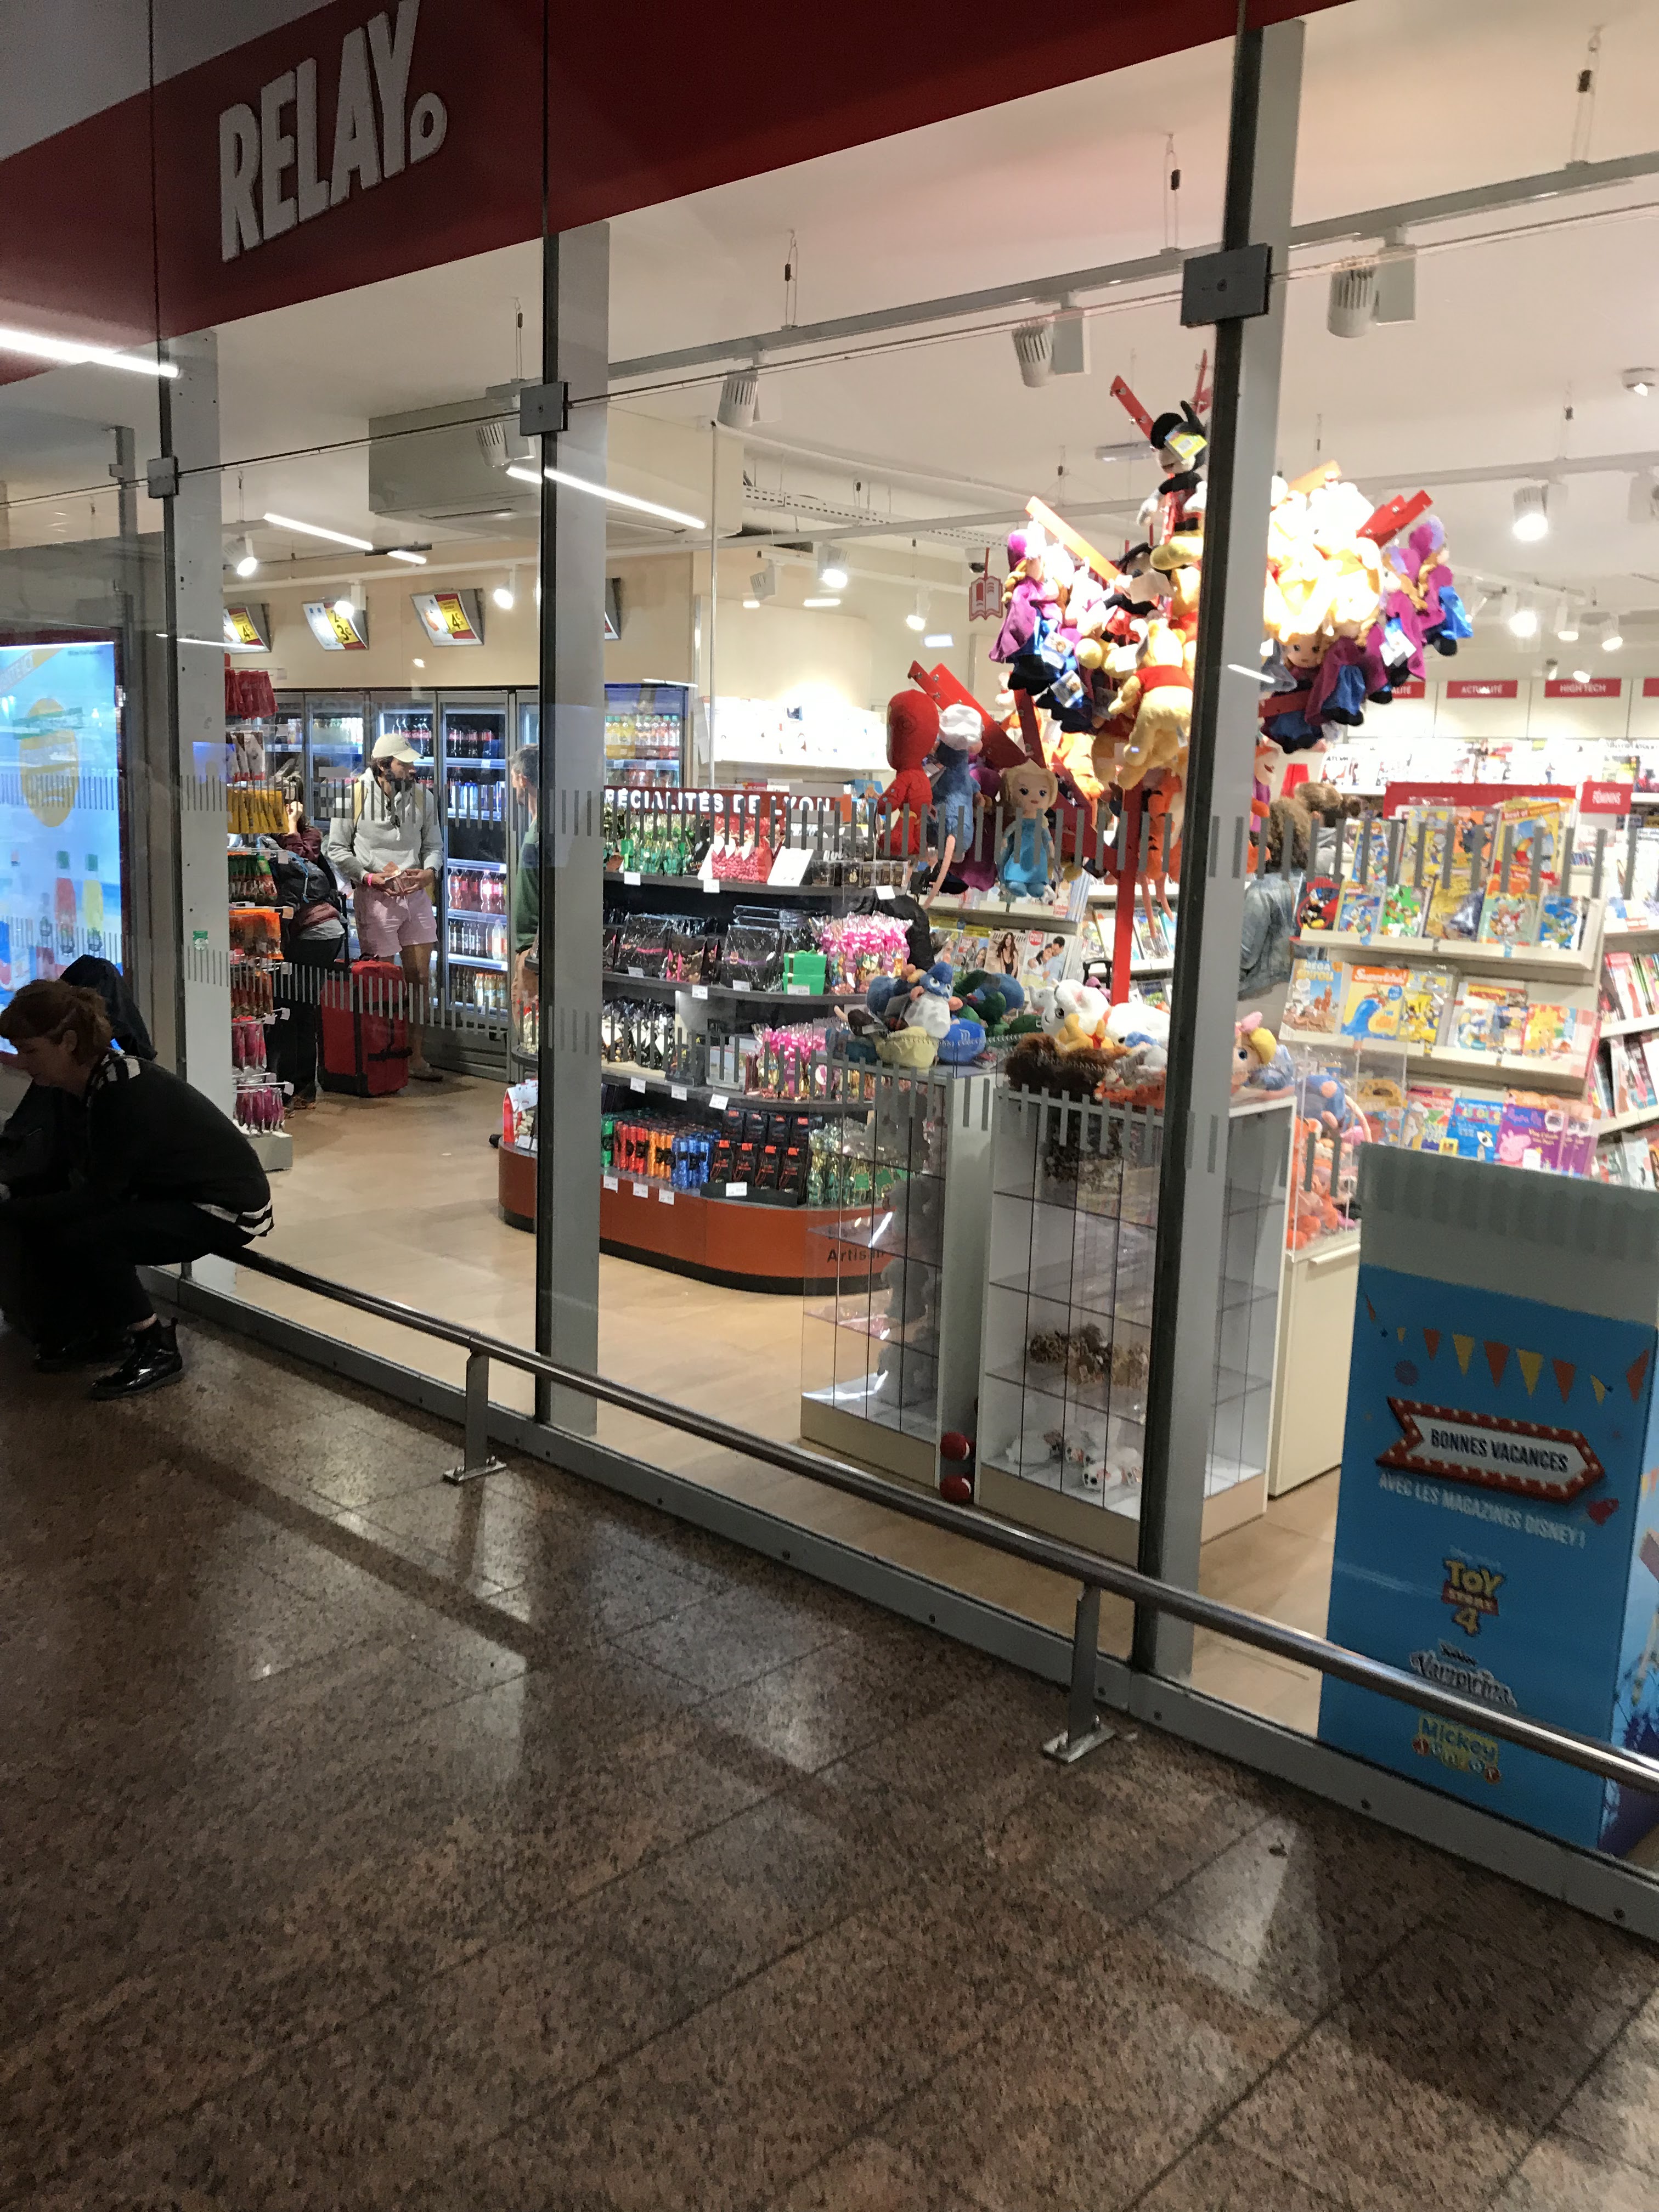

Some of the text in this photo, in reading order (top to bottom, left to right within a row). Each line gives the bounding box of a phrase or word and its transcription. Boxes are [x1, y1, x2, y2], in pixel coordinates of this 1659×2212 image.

[219, 0, 421, 263] RELAY
[1391, 685, 1412, 695] ALITÉ
[605, 788, 724, 812] PÉCIALITÉS
[733, 793, 761, 814] DE
[1430, 1427, 1569, 1473] BONNES VACANCES
[1444, 1558, 1505, 1598] TOY
[1453, 1606, 1480, 1635] 4
